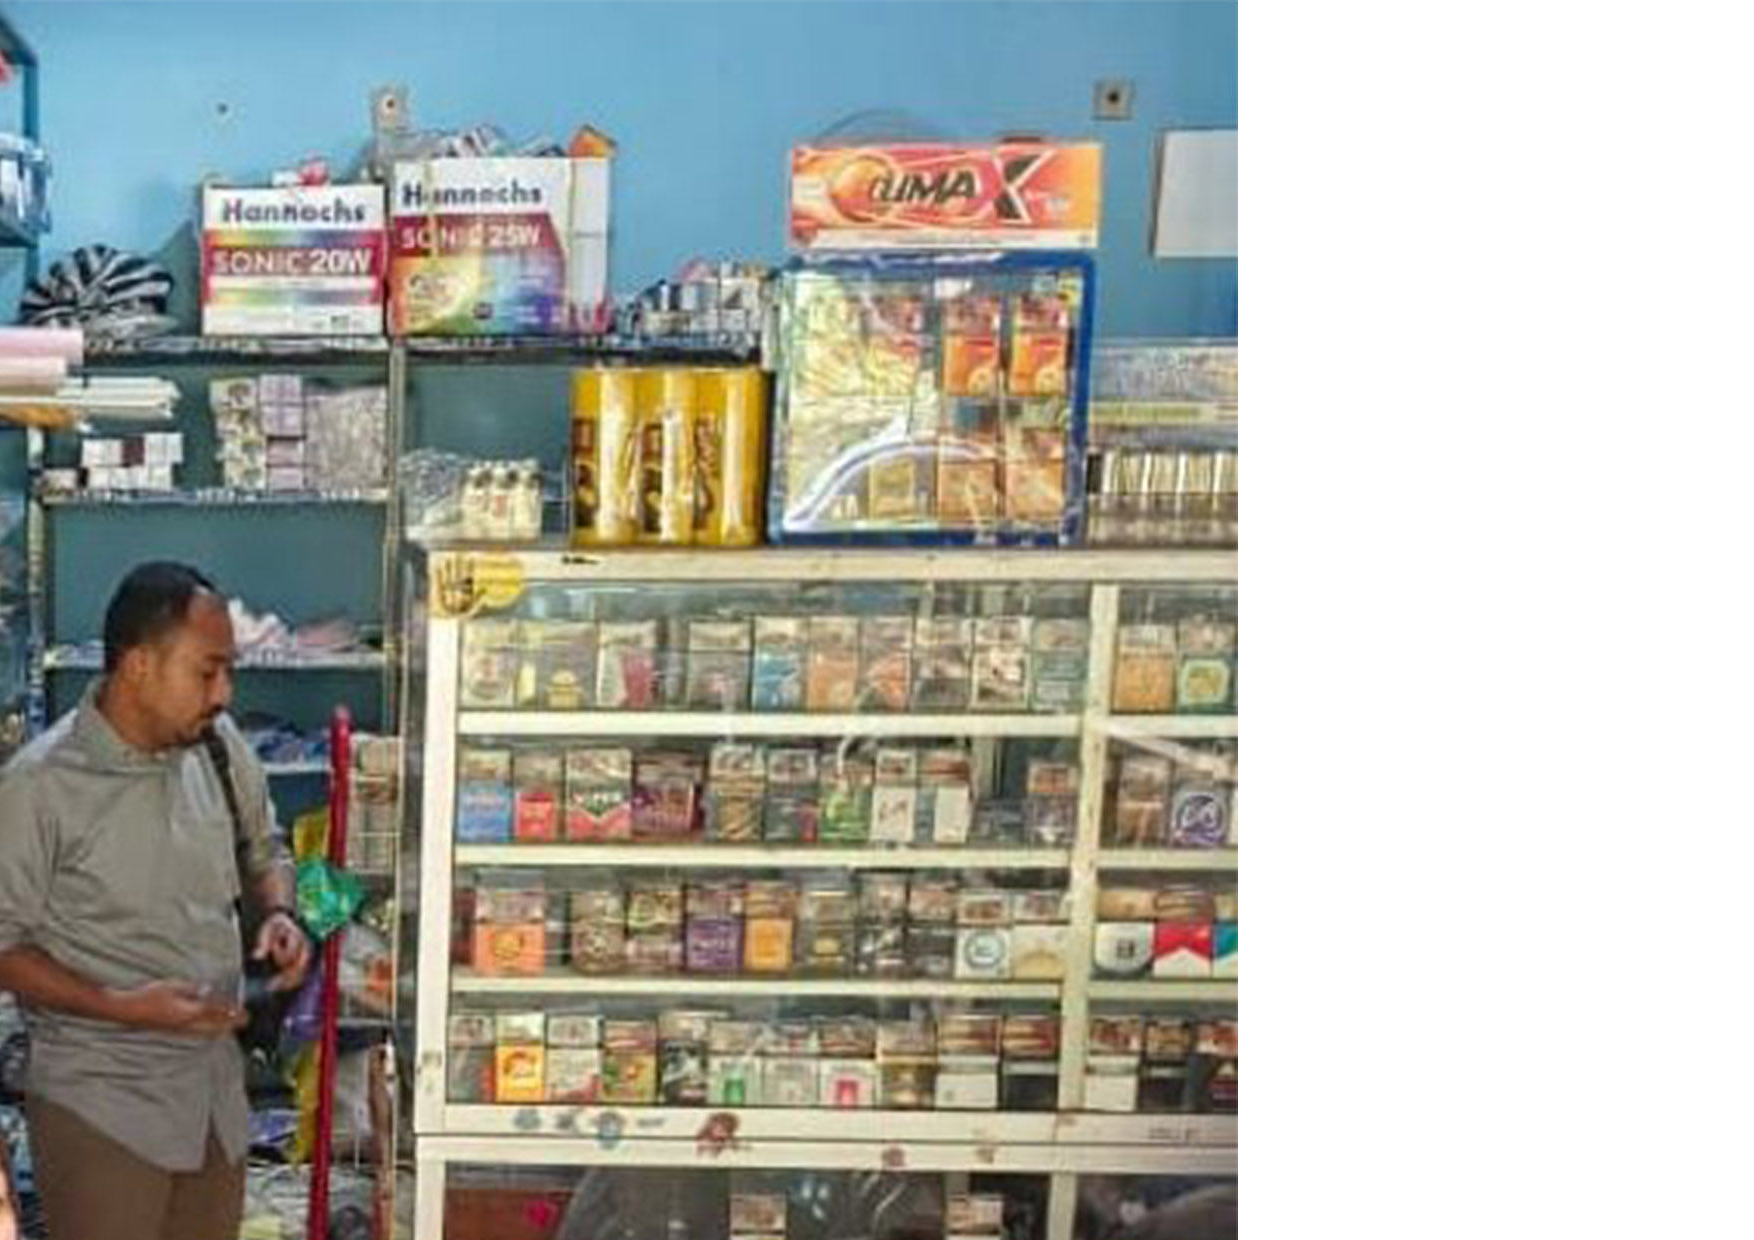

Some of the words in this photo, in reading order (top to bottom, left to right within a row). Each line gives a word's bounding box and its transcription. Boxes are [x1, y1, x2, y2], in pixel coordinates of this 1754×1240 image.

[222, 197, 366, 223] Hannochs
[487, 222, 541, 248] 25W
[213, 250, 307, 275] SONIC
[309, 247, 372, 272] 20W
